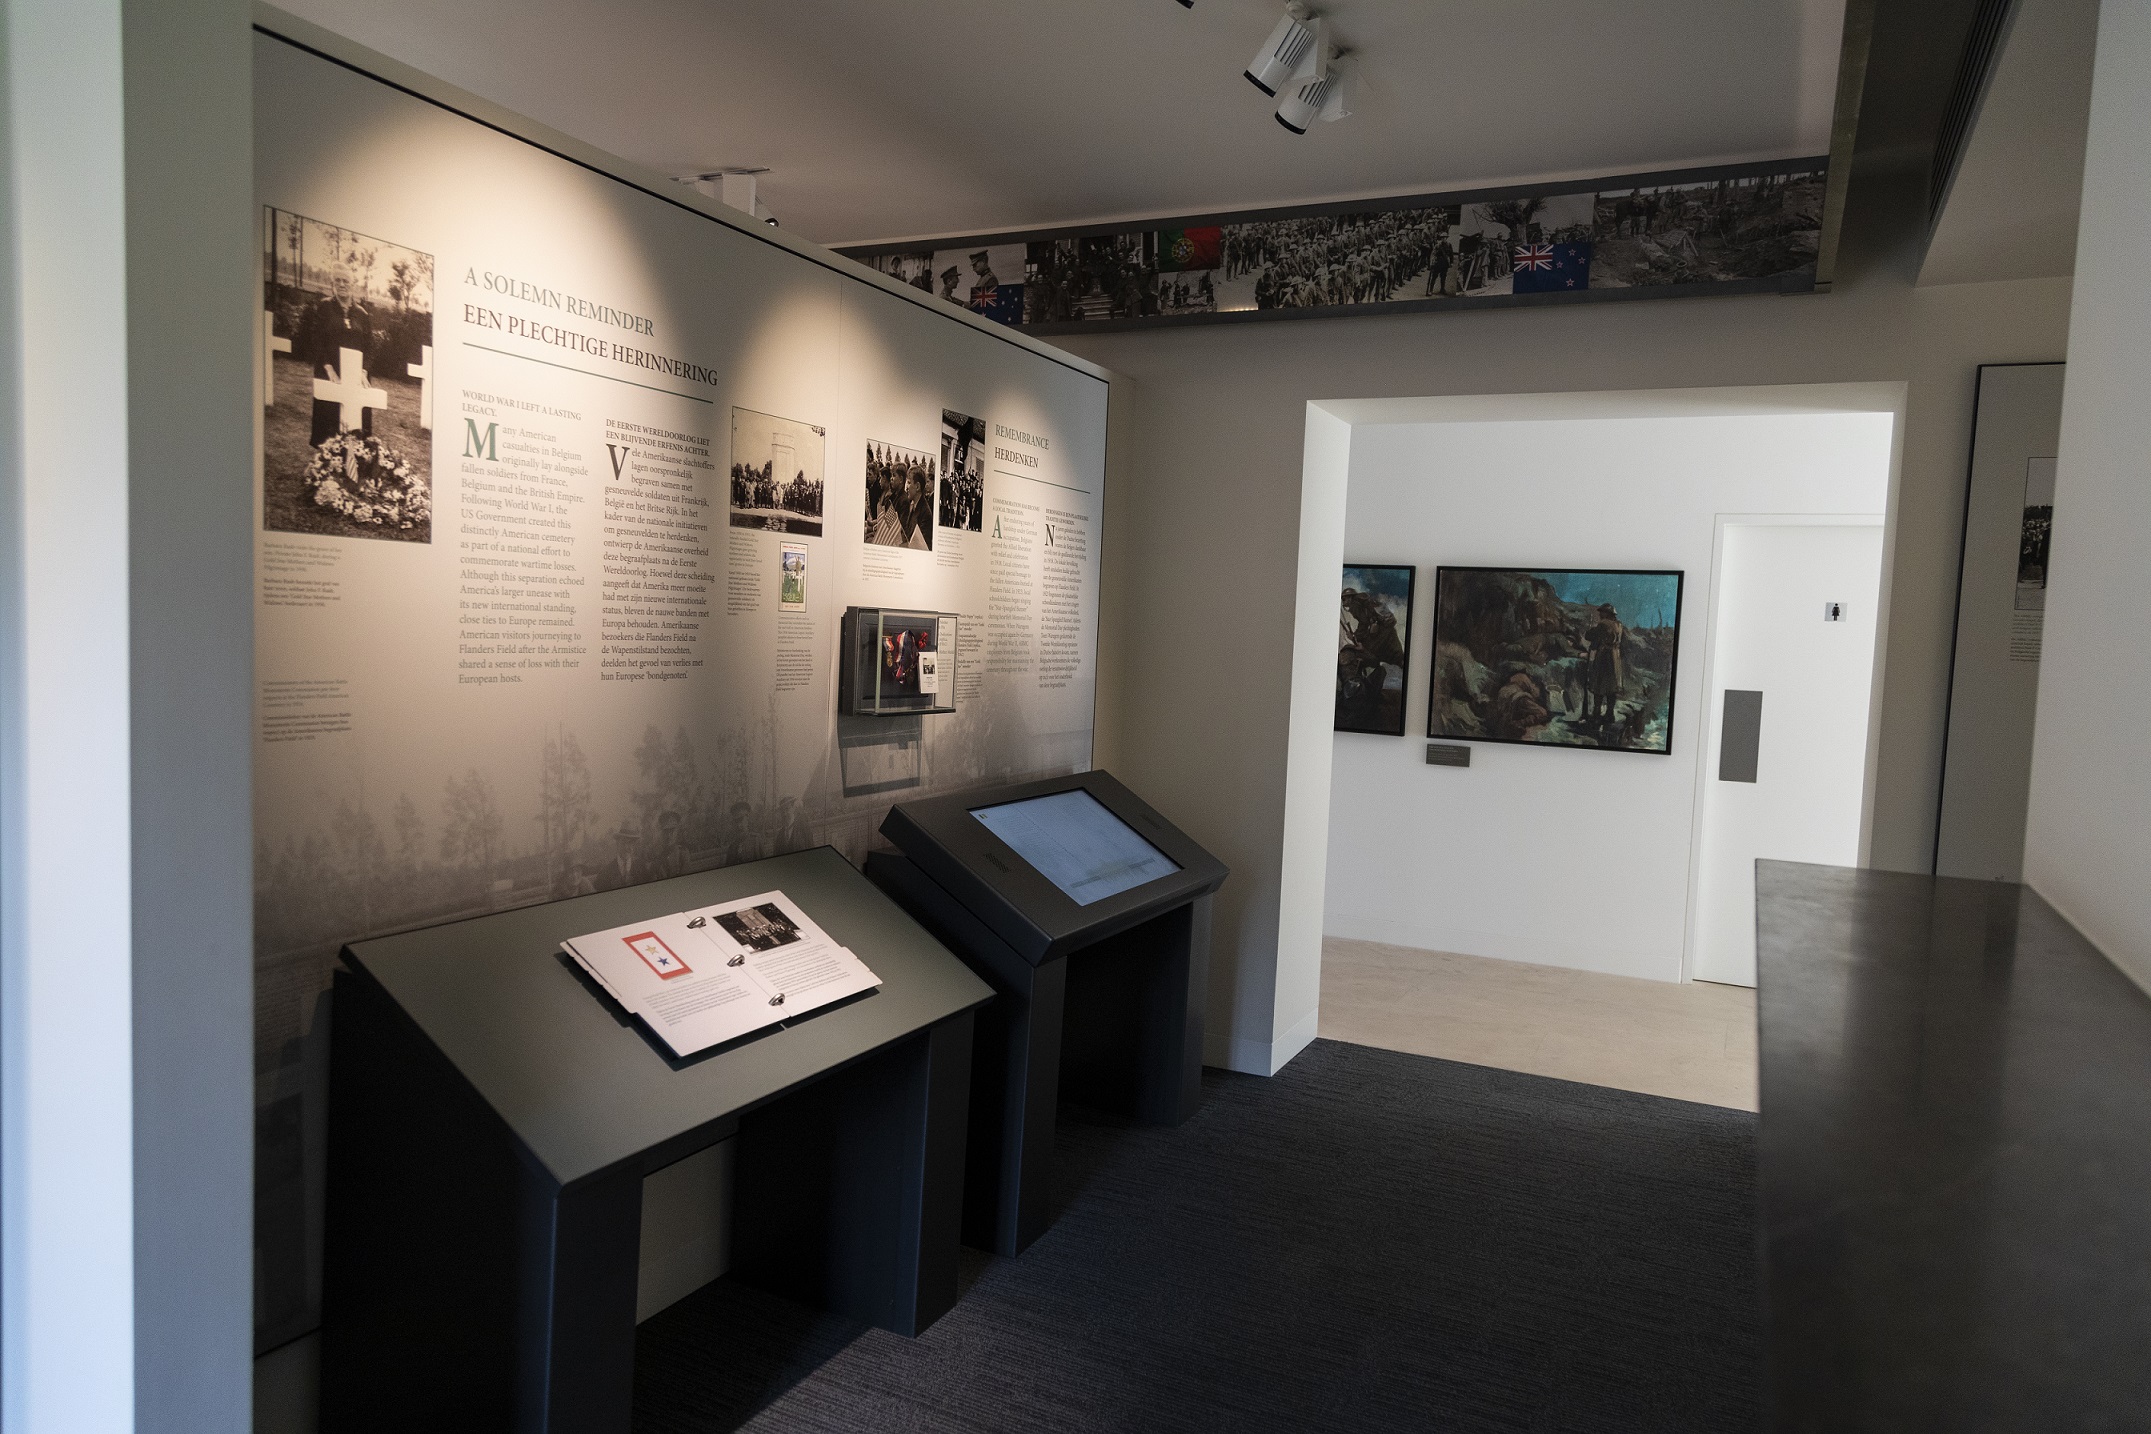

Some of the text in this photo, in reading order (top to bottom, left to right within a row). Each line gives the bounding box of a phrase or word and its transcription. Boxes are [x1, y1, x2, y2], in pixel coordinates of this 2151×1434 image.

[464, 266, 654, 337] A SOLEMN REMINDER
[463, 303, 718, 386] EEN PLECHTIGE HERINNERING
[462, 390, 581, 421] WORLD WAR I LEFT A LASTING
[462, 402, 497, 417] LEGACY.
[519, 428, 556, 442] American
[995, 424, 1049, 450] REMEMBRANCE
[502, 442, 581, 461] casualties in Belgium
[994, 447, 1038, 468] HERDENKEN
[502, 455, 588, 476] originally lay alongside
[461, 463, 568, 488] fallen soldiers from France,
[461, 479, 584, 504] Belgium and the British Empire.
[461, 494, 502, 510] Following
[505, 499, 529, 510] World
[531, 502, 546, 512] War
[556, 504, 567, 514] the
[461, 509, 571, 529] US Government created this
[460, 523, 575, 546] distinctly American cemetery
[471, 543, 488, 553] part
[490, 541, 498, 551] of
[507, 544, 539, 554] national
[541, 546, 561, 556] effort
[563, 549, 570, 557] to
[460, 557, 577, 571] commemorate wartime losses.
[460, 569, 585, 586] Although this separation echoed
[501, 586, 524, 599] larger
[554, 589, 570, 598] with
[459, 599, 469, 609] its
[491, 601, 541, 611] international
[543, 603, 577, 615] standing,
[459, 614, 574, 628] close ties to Europe remained.
[459, 630, 500, 639] American
[502, 630, 530, 639] visitors
[532, 631, 572, 643] journeying
[459, 644, 586, 654] Flanders Field after the Armistice
[458, 659, 486, 668] shared
[518, 658, 526, 668] of
[528, 658, 542, 668] loss
[544, 658, 560, 668] with
[562, 658, 579, 667] their
[458, 673, 522, 686] European hosts.
